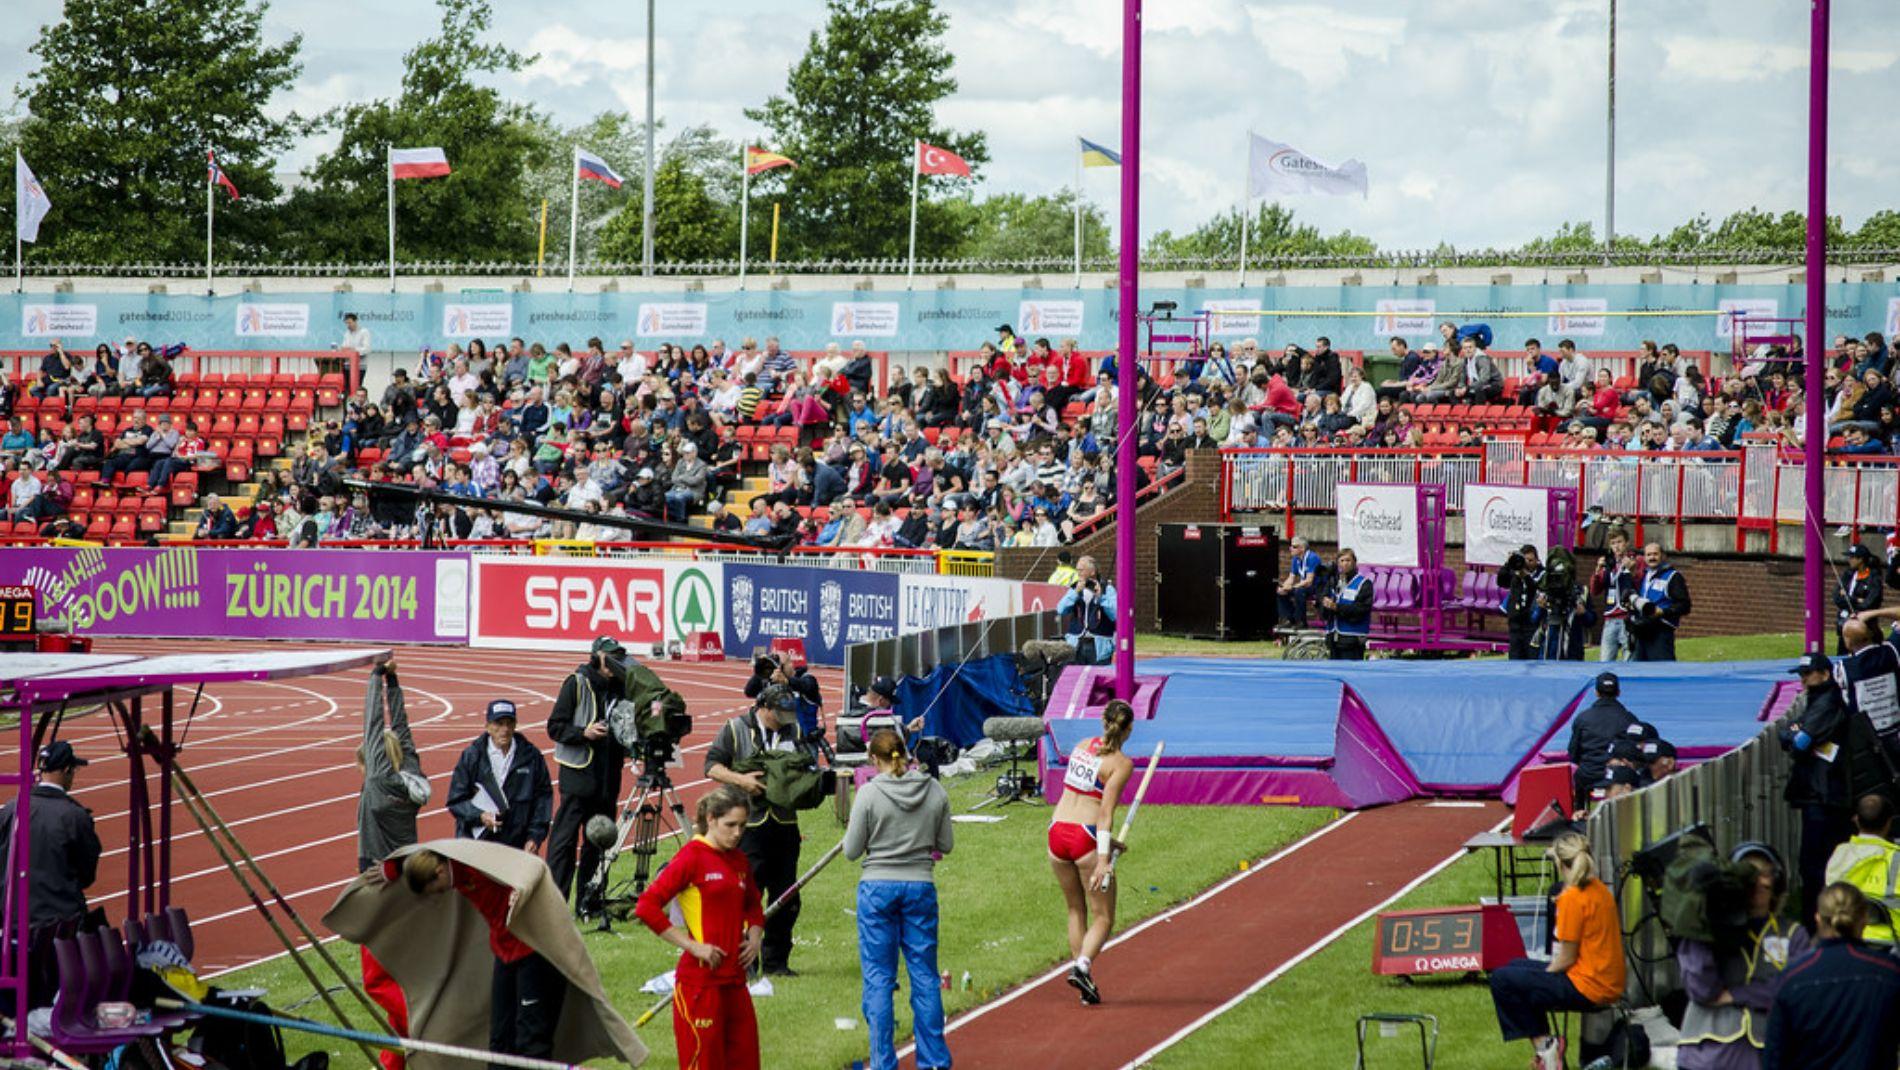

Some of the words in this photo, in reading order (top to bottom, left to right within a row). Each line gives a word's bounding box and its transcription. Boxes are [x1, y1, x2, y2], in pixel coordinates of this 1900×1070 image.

[1280, 155, 1328, 171] Gates
[119, 310, 214, 324] gateshead2013.com
[337, 310, 414, 321] #eshead2013
[529, 310, 617, 323] gateshead2013.com
[1360, 509, 1402, 531] Gateshead
[1490, 509, 1533, 532] Gateshead
[226, 562, 347, 618] ZÜRICH
[352, 574, 418, 620] 2014
[760, 587, 808, 614] BRITISH
[525, 575, 662, 633] SPAR
[849, 593, 893, 620] BRITISH
[906, 585, 919, 627] LE
[758, 618, 808, 638] ATHLETICS
[846, 624, 894, 641] ATHLETICS
[1070, 761, 1094, 783] NOR
[1391, 917, 1473, 953] 0:53
[1430, 956, 1480, 970] OMEGA
